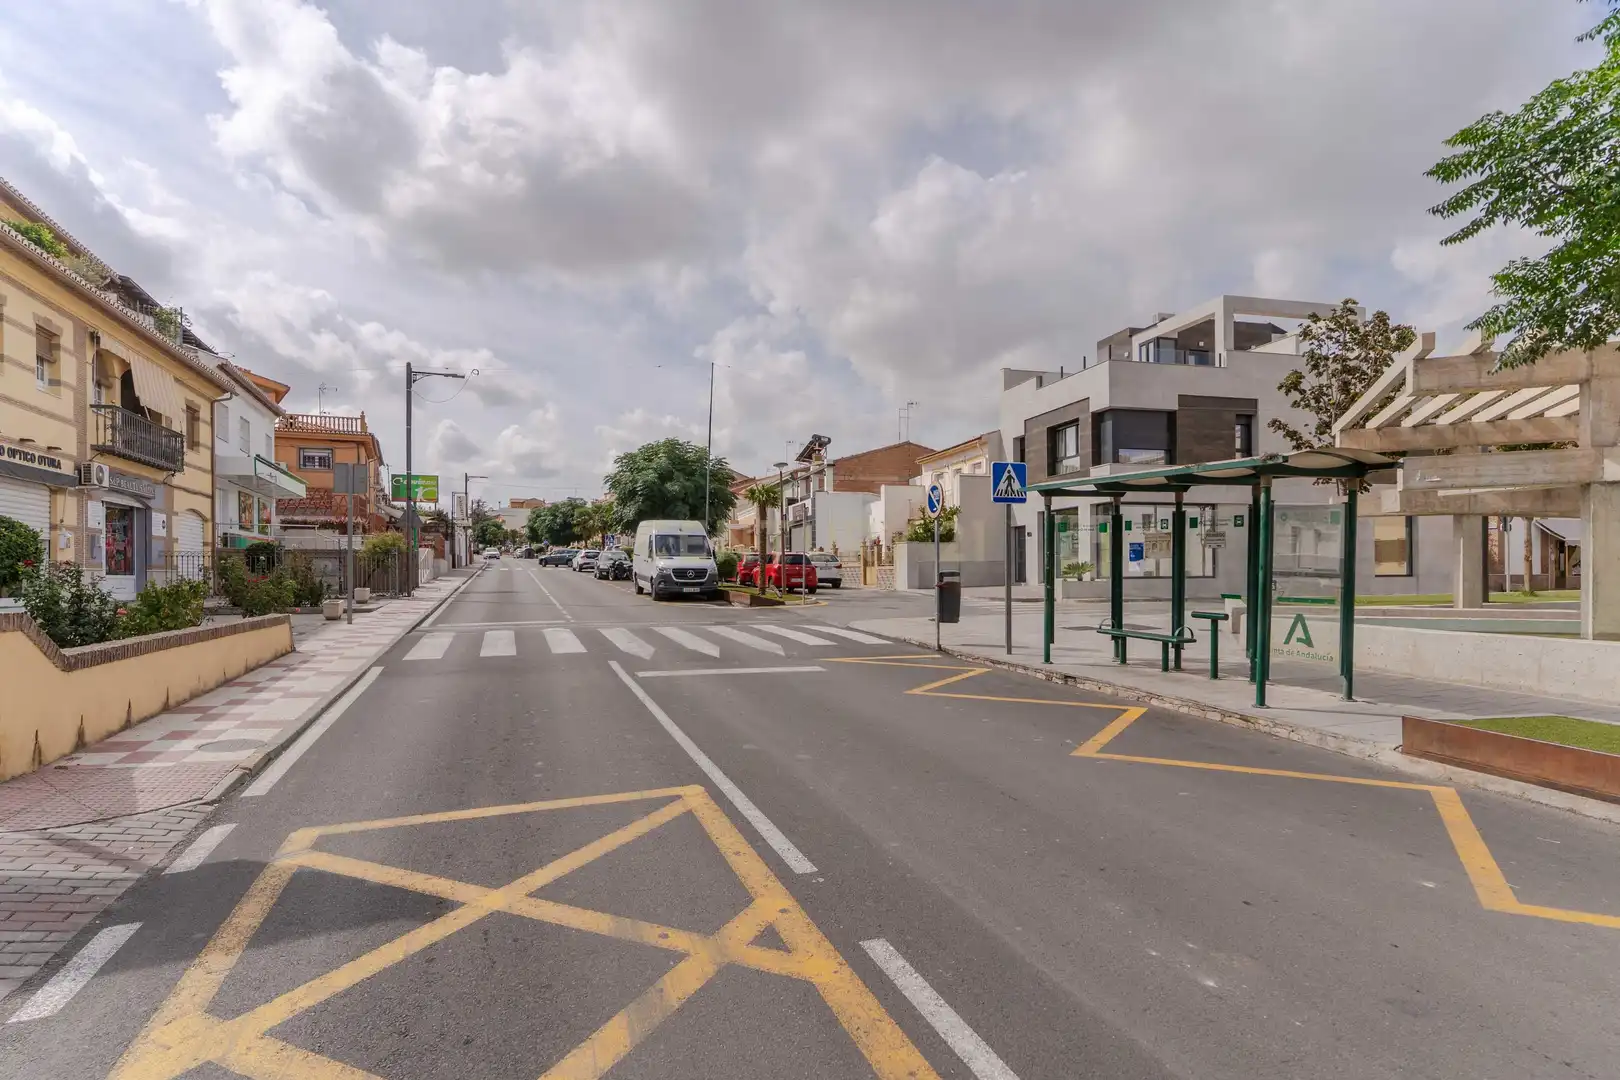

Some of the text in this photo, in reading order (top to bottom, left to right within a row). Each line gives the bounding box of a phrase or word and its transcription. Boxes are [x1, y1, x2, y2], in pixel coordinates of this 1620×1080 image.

[7, 447, 36, 463] OPTICO
[1286, 648, 1295, 656] de
[1296, 650, 1334, 662] Andalucía
